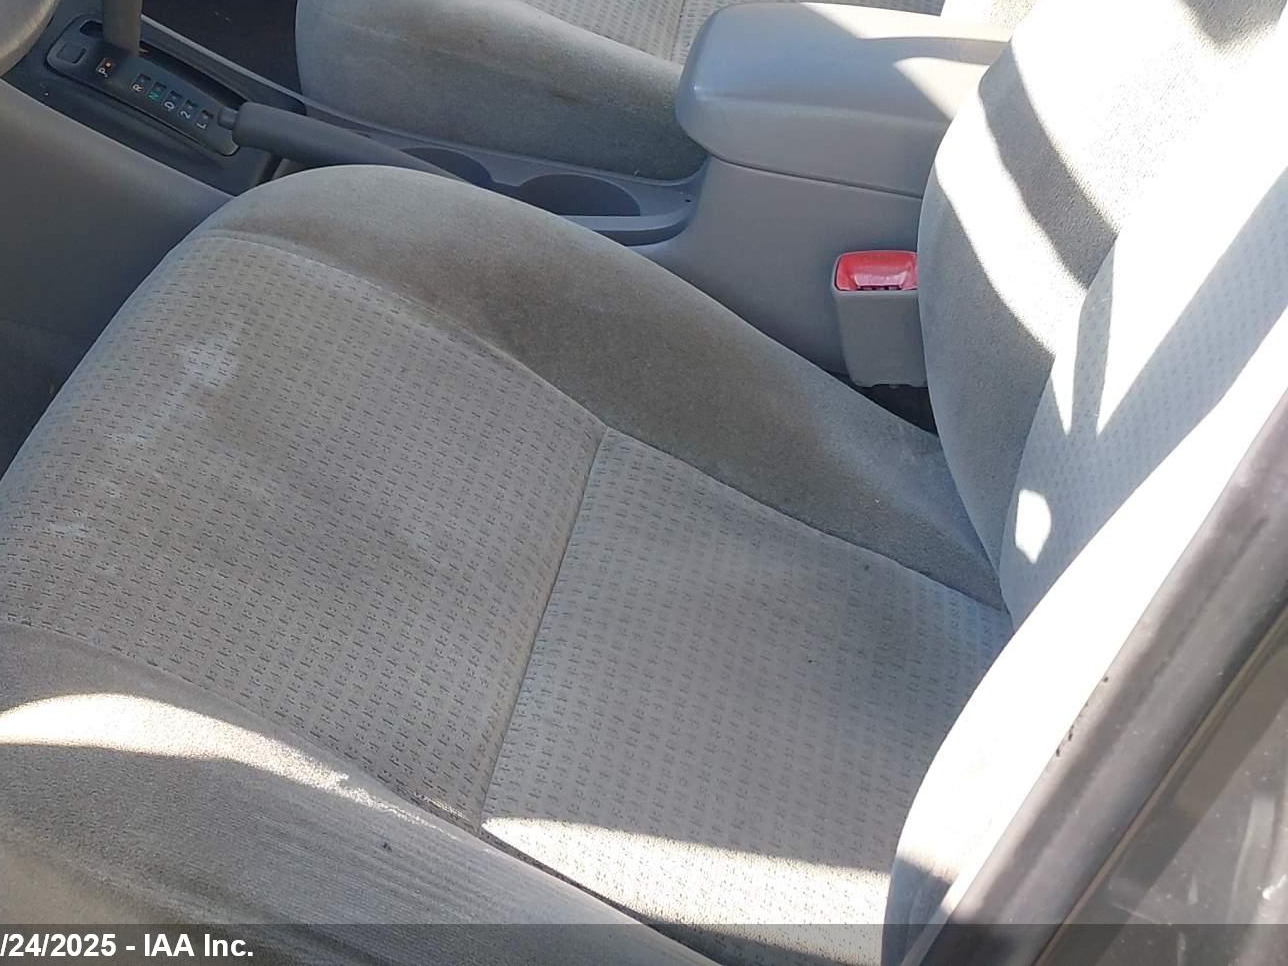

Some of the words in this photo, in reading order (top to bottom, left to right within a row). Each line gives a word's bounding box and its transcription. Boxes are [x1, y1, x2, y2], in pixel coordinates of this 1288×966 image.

[98, 67, 108, 78] P
[132, 84, 143, 92] R
[164, 101, 175, 111] D
[180, 110, 191, 119] 2
[196, 122, 208, 130] L
